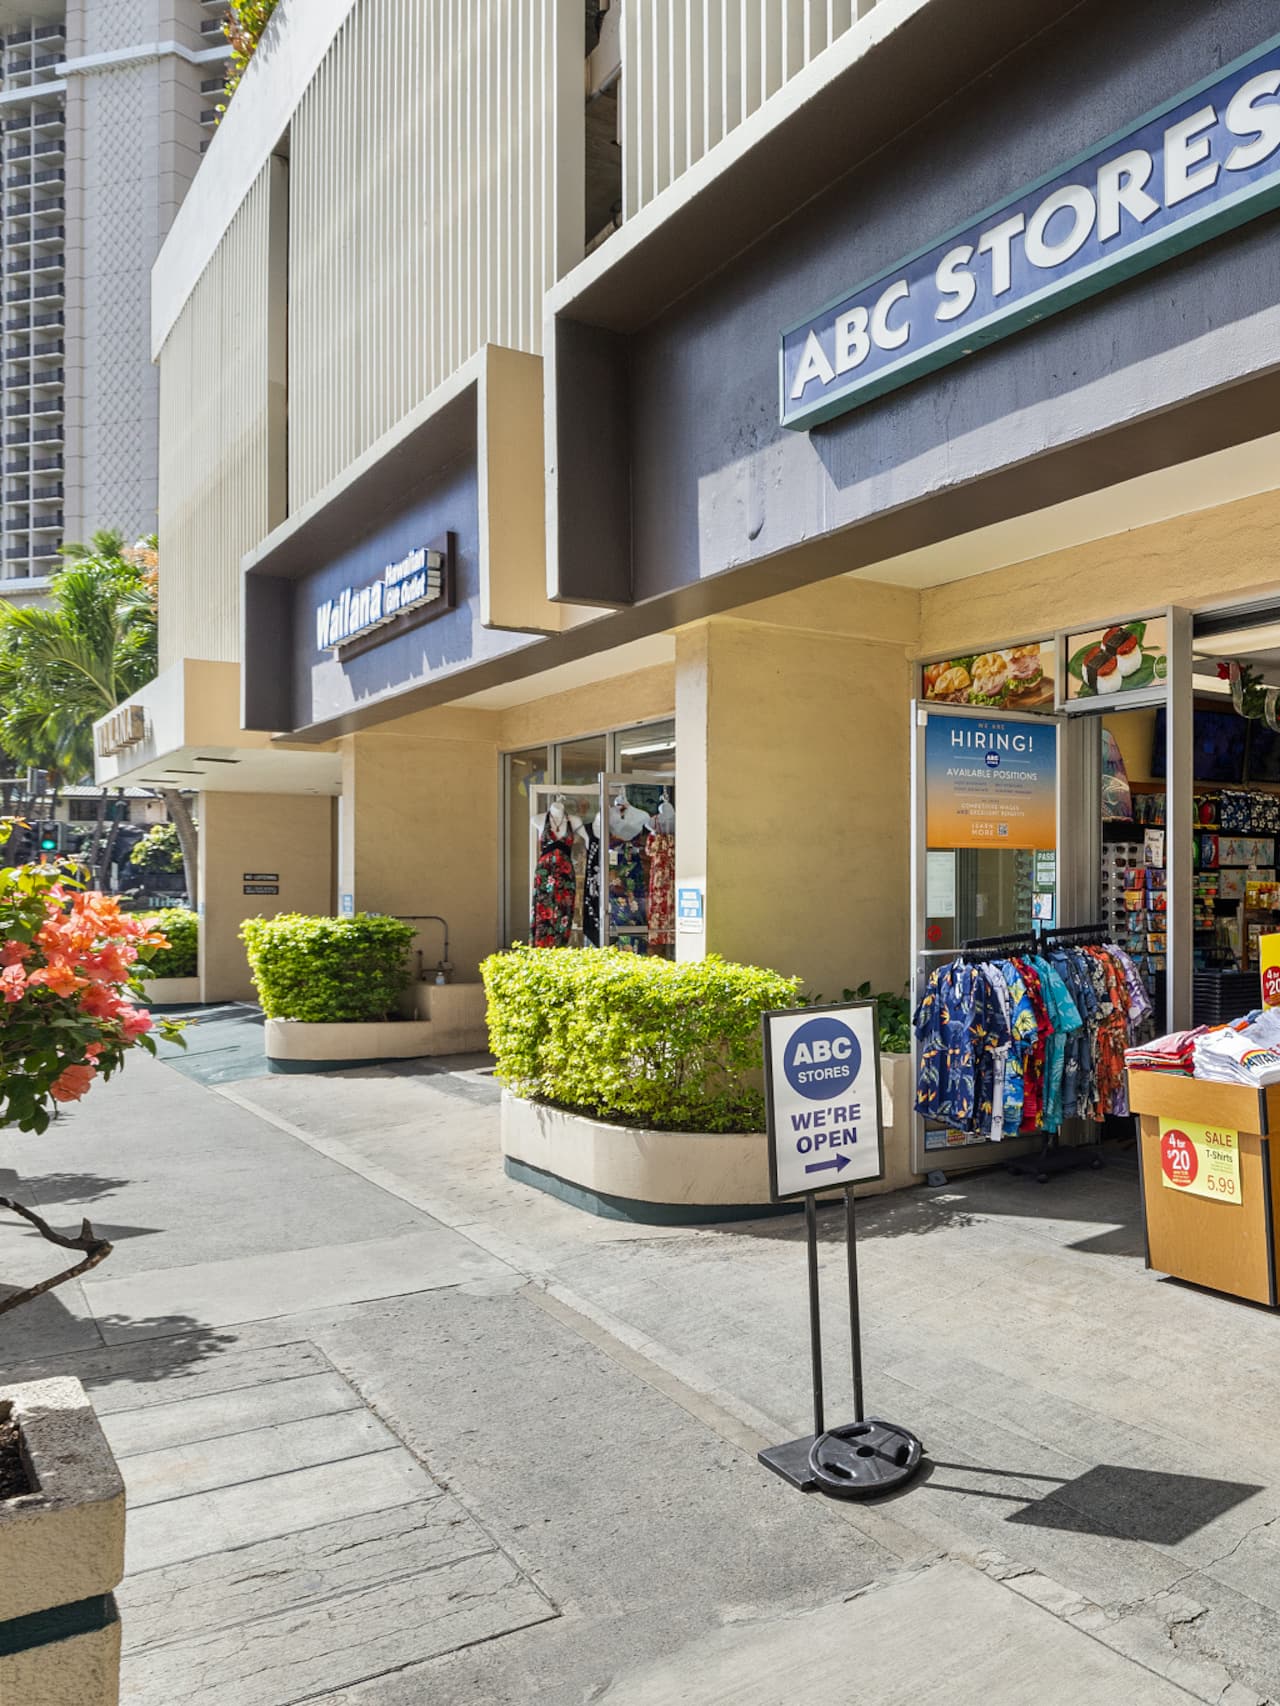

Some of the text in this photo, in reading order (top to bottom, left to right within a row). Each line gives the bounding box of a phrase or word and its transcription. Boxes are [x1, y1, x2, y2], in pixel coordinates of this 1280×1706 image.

[789, 279, 911, 400] ABC
[951, 730, 1033, 752] HIRING!
[946, 767, 1038, 781] AVAILABLE POSITIONS
[1266, 969, 1273, 979] 4
[793, 1037, 852, 1066] ABC
[798, 1065, 850, 1084] STORES
[791, 1103, 861, 1131] WE'RE
[796, 1127, 858, 1154] OPEN
[1168, 1133, 1176, 1147] 4
[1204, 1130, 1232, 1147] SALE
[1167, 1149, 1191, 1170] $20
[1205, 1149, 1233, 1163] T-Shirts
[1207, 1174, 1235, 1195] 5.99
